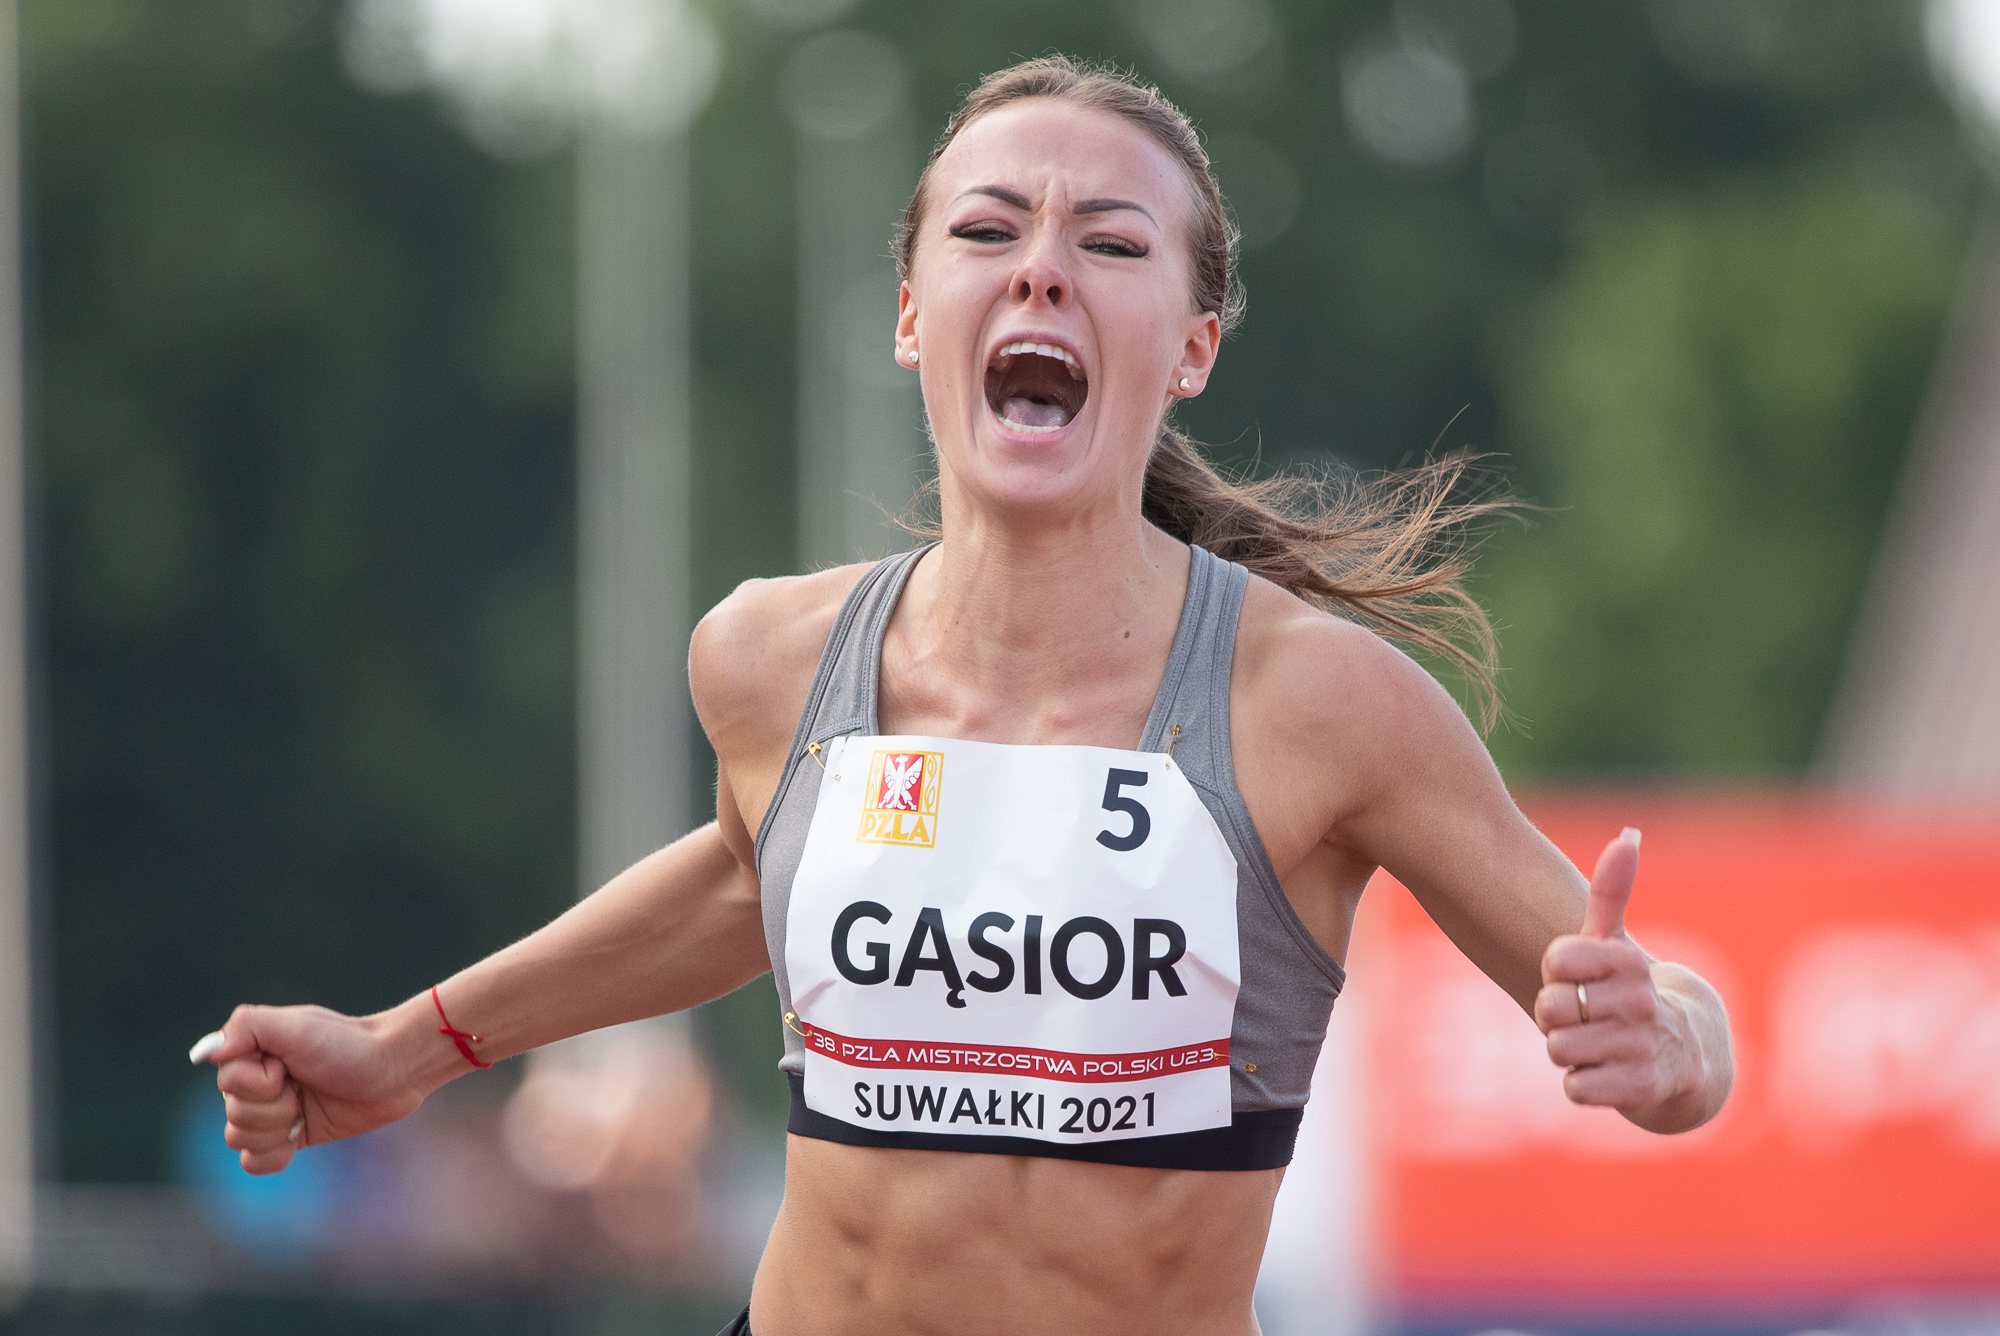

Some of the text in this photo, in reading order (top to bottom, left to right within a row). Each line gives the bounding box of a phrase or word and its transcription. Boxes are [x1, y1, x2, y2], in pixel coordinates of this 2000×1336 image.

[861, 813, 930, 843] PZLA
[1095, 767, 1151, 852] 5
[831, 900, 1188, 1009] GĄSIOR
[813, 1032, 1215, 1076] 38. PZLA MISTRZOSTWA POLSKI U23
[854, 1081, 1155, 1134] SUWAŁKI 2021
